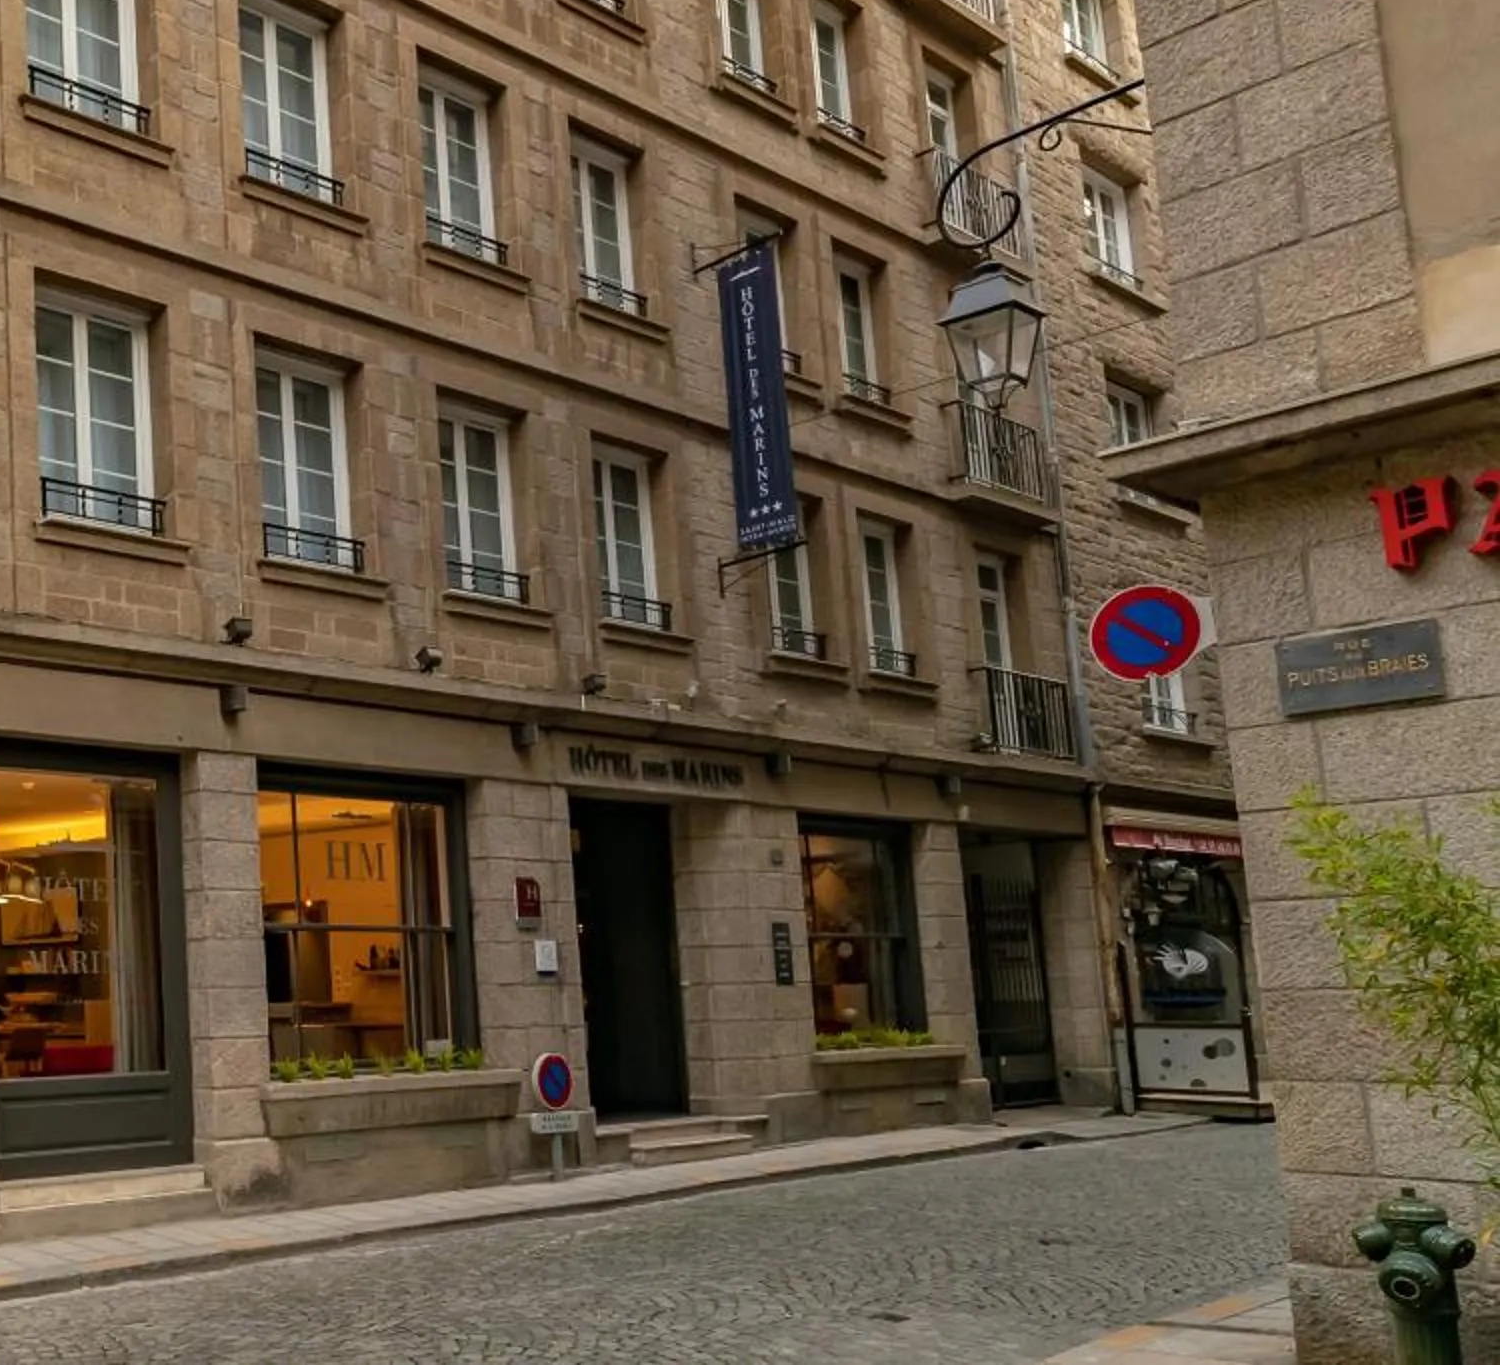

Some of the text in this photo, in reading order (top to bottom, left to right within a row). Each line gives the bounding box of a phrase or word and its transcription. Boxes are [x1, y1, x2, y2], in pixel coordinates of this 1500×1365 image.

[740, 286, 757, 362] HÔTEL
[750, 405, 769, 498] MARINS
[1286, 666, 1337, 688] PUITS
[568, 743, 639, 782] HÔTEL
[671, 758, 745, 788] MARINS
[325, 840, 388, 883] HM
